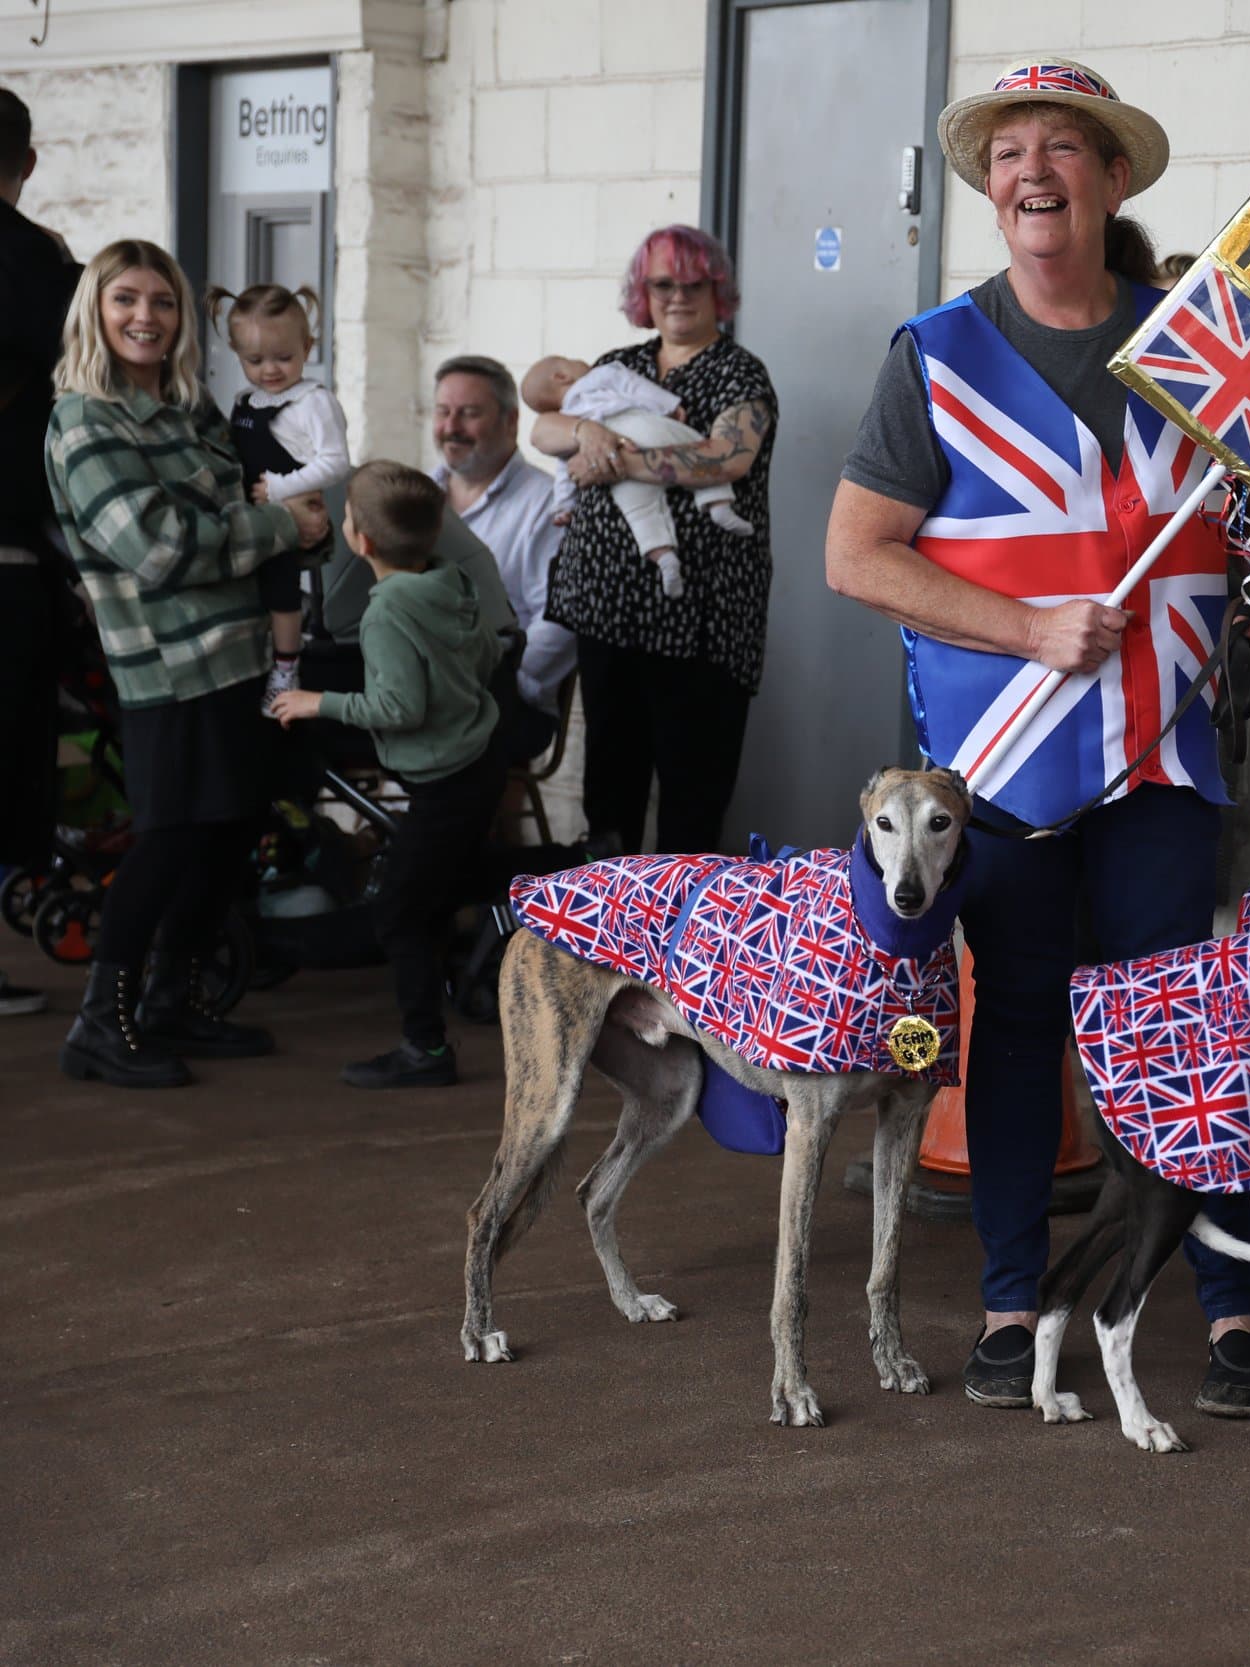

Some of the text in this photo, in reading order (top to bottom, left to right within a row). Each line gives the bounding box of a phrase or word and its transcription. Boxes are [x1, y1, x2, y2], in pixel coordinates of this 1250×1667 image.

[239, 94, 327, 145] Betting
[255, 146, 310, 168] Enquiries
[892, 1030, 934, 1048] TEAM
